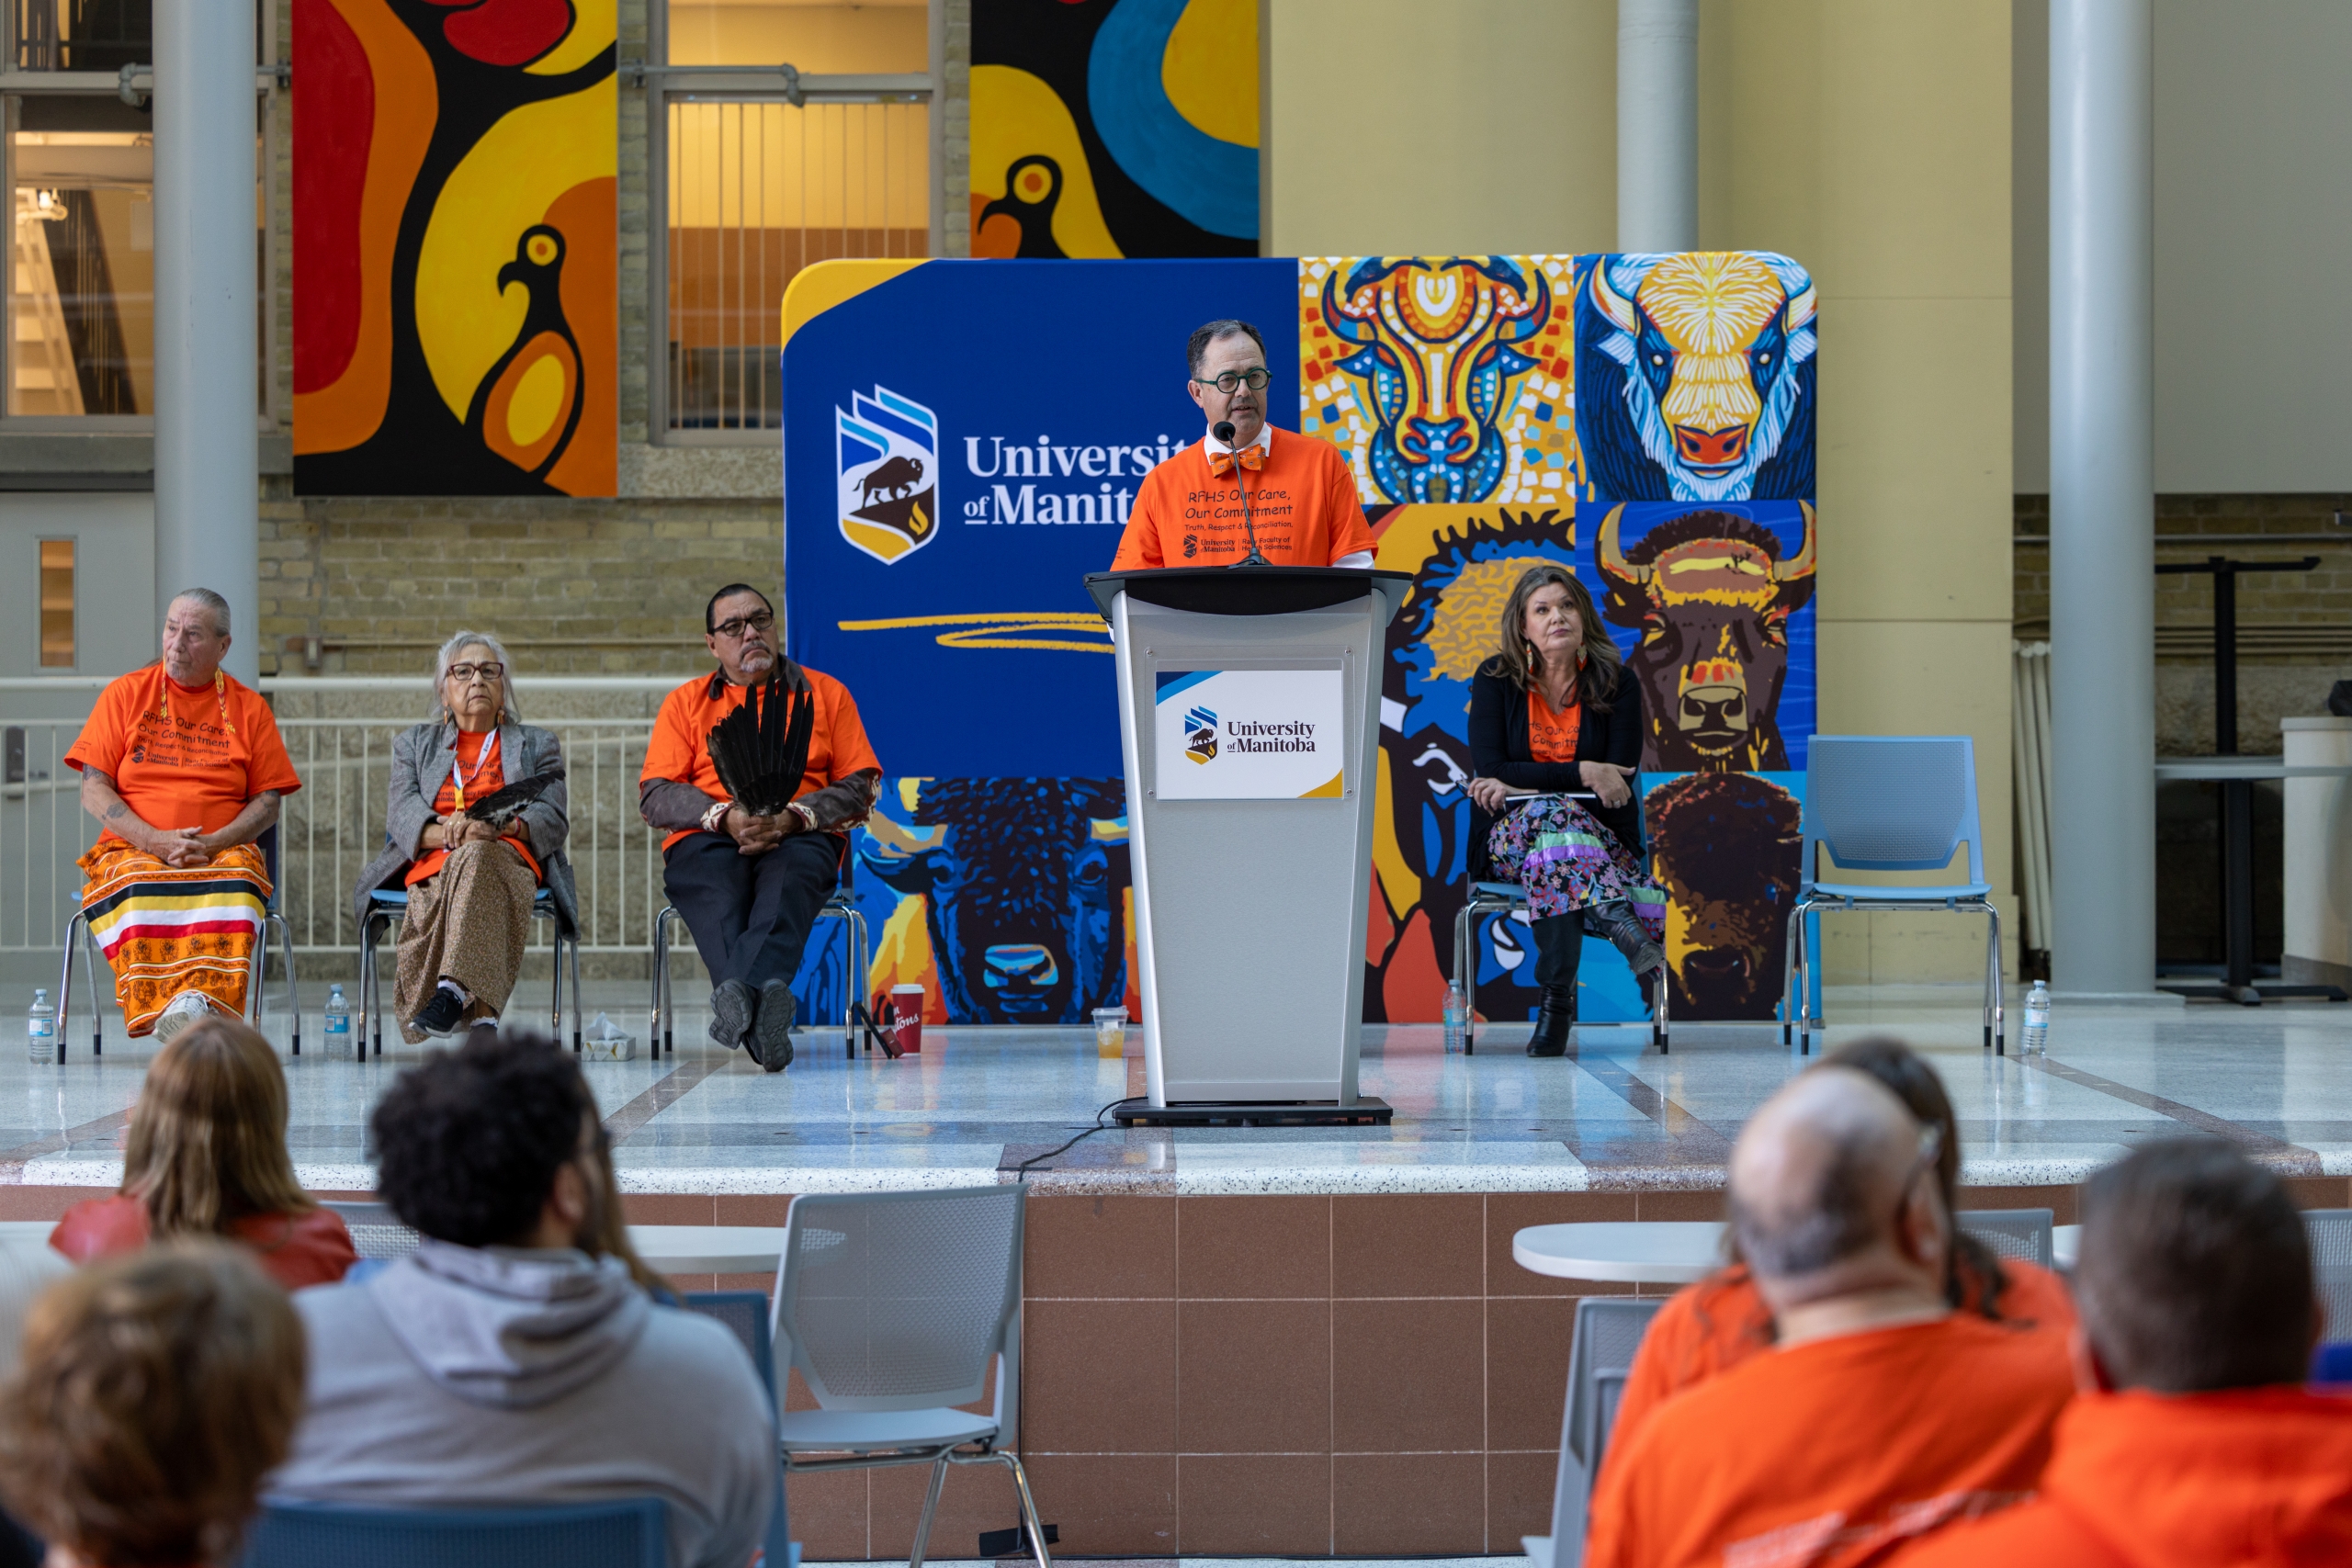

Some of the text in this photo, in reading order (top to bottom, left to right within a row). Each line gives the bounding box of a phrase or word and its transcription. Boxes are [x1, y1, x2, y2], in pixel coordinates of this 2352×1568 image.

[964, 434, 1191, 477] Universi
[964, 482, 1136, 525] of Manit
[1189, 491, 1225, 503] RFHS
[1258, 489, 1291, 501] Care,
[1185, 504, 1293, 519] Our Commitment
[1208, 524, 1236, 532] Respect
[1260, 536, 1282, 545] Faculty
[142, 710, 172, 726] RFHS
[176, 717, 196, 730] Our
[138, 724, 230, 749] Our Commitment
[1227, 720, 1316, 739] University
[1227, 738, 1316, 752] of Manitoba
[147, 751, 179, 761] University
[896, 1013, 919, 1031] tons
